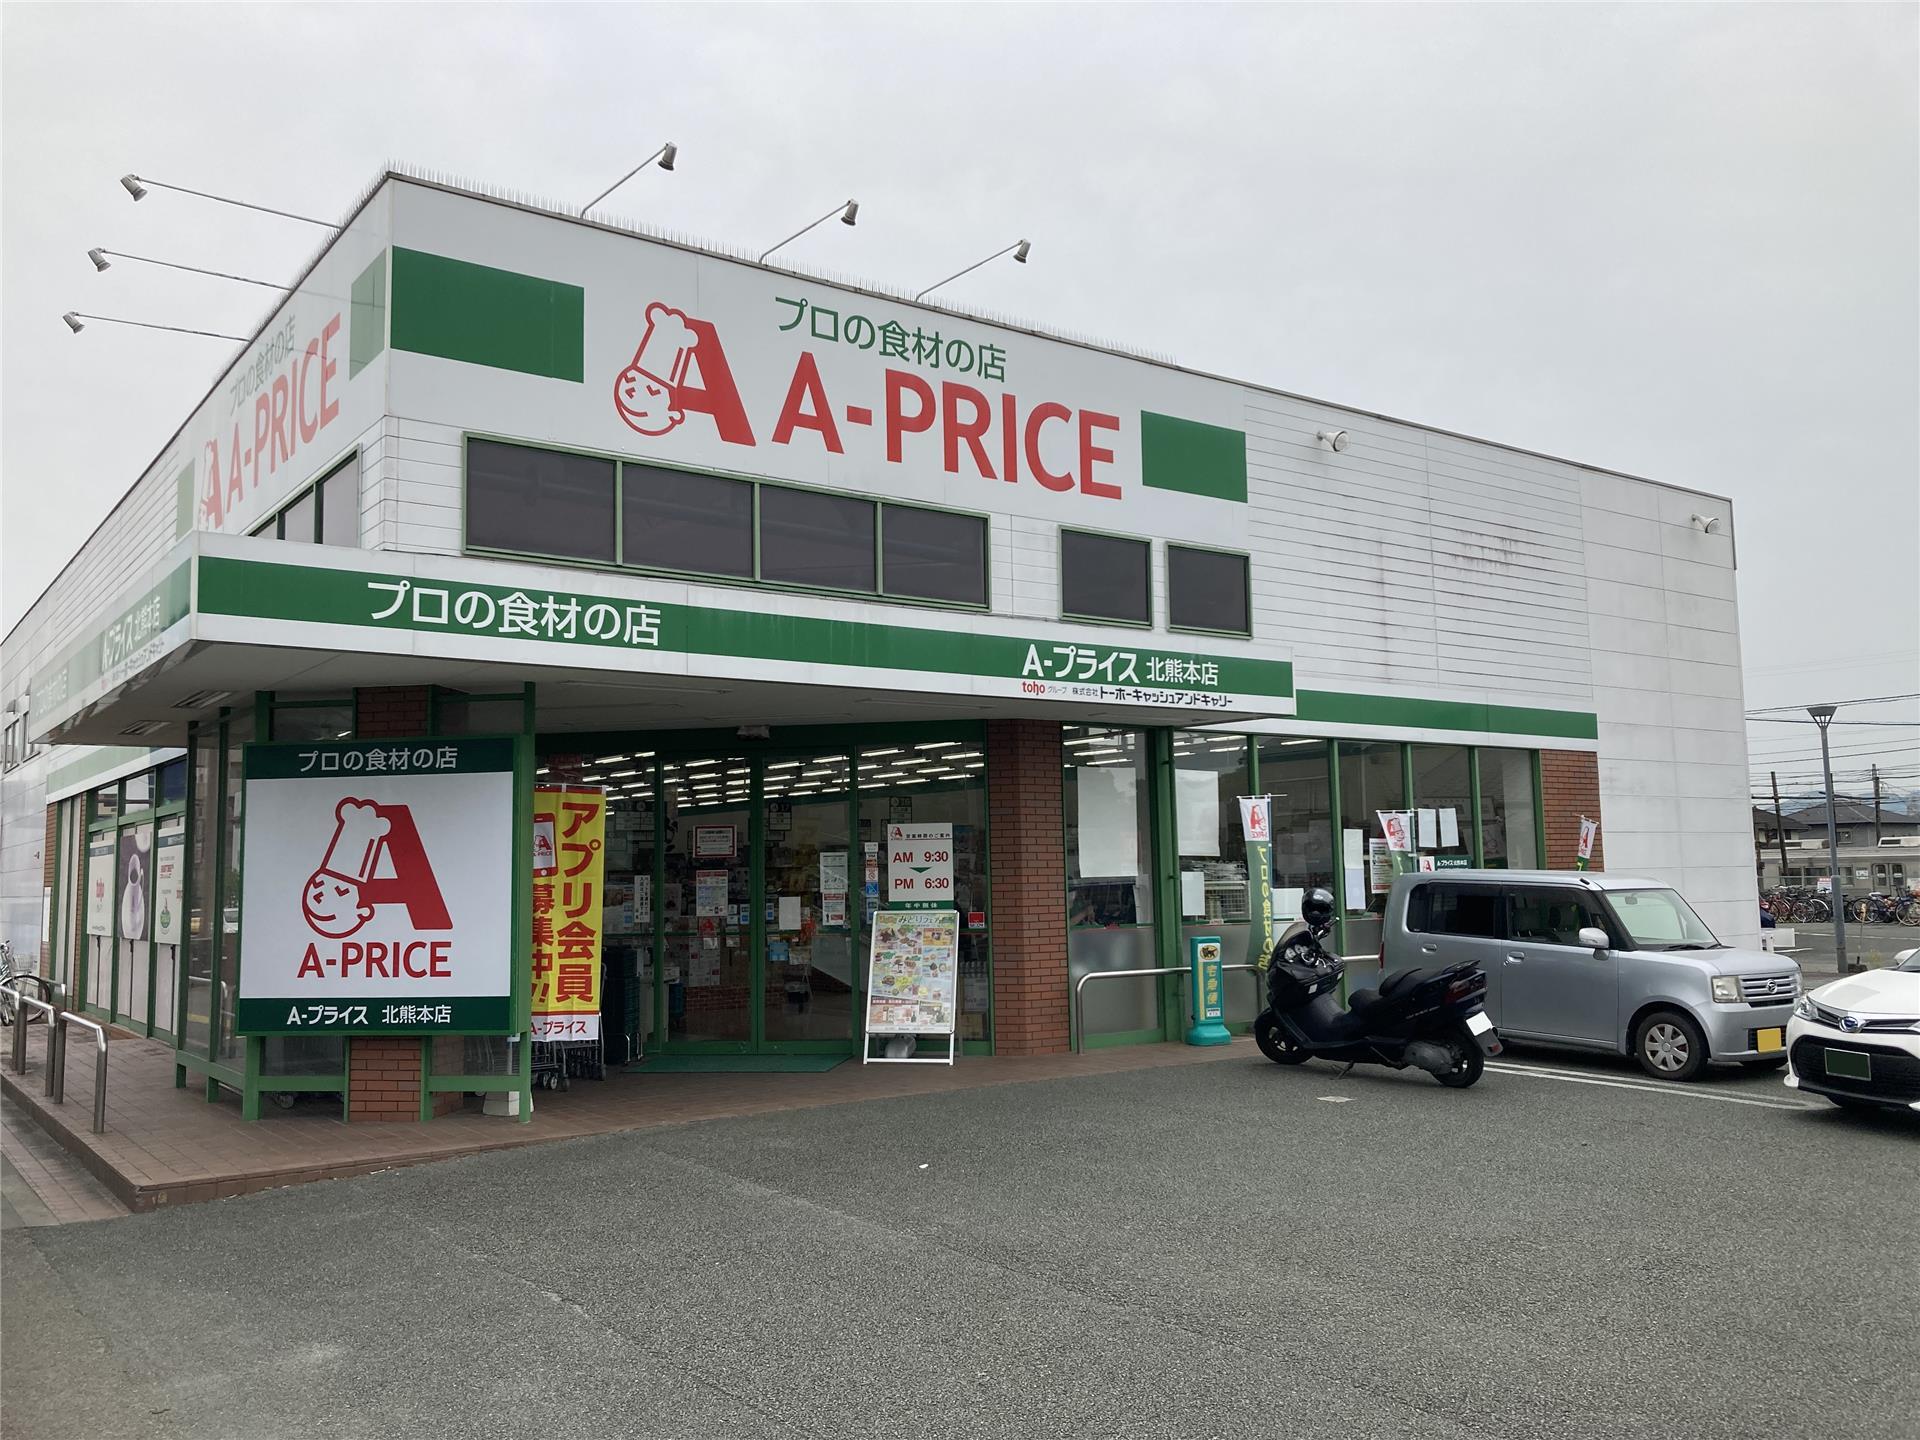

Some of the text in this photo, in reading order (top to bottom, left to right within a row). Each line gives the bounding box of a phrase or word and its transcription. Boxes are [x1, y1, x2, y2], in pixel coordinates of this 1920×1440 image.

[775, 296, 1007, 383] プロの食材の店
[230, 313, 296, 416] プロの食材の店
[226, 312, 341, 514] A-PRICE
[772, 351, 1122, 500] A-PRICE
[367, 579, 662, 646] プロの食材の店
[1021, 643, 1219, 686] A-プライス 北熊本店
[1022, 681, 1046, 695] toho
[298, 747, 458, 772] プロの食材の店
[892, 851, 949, 863] AM 9:30
[556, 802, 602, 1003] アプリ会員
[894, 878, 949, 889] PM 6:30
[296, 941, 452, 978] A-PRICE
[287, 1004, 451, 1025] A-プライス 北熊本店
